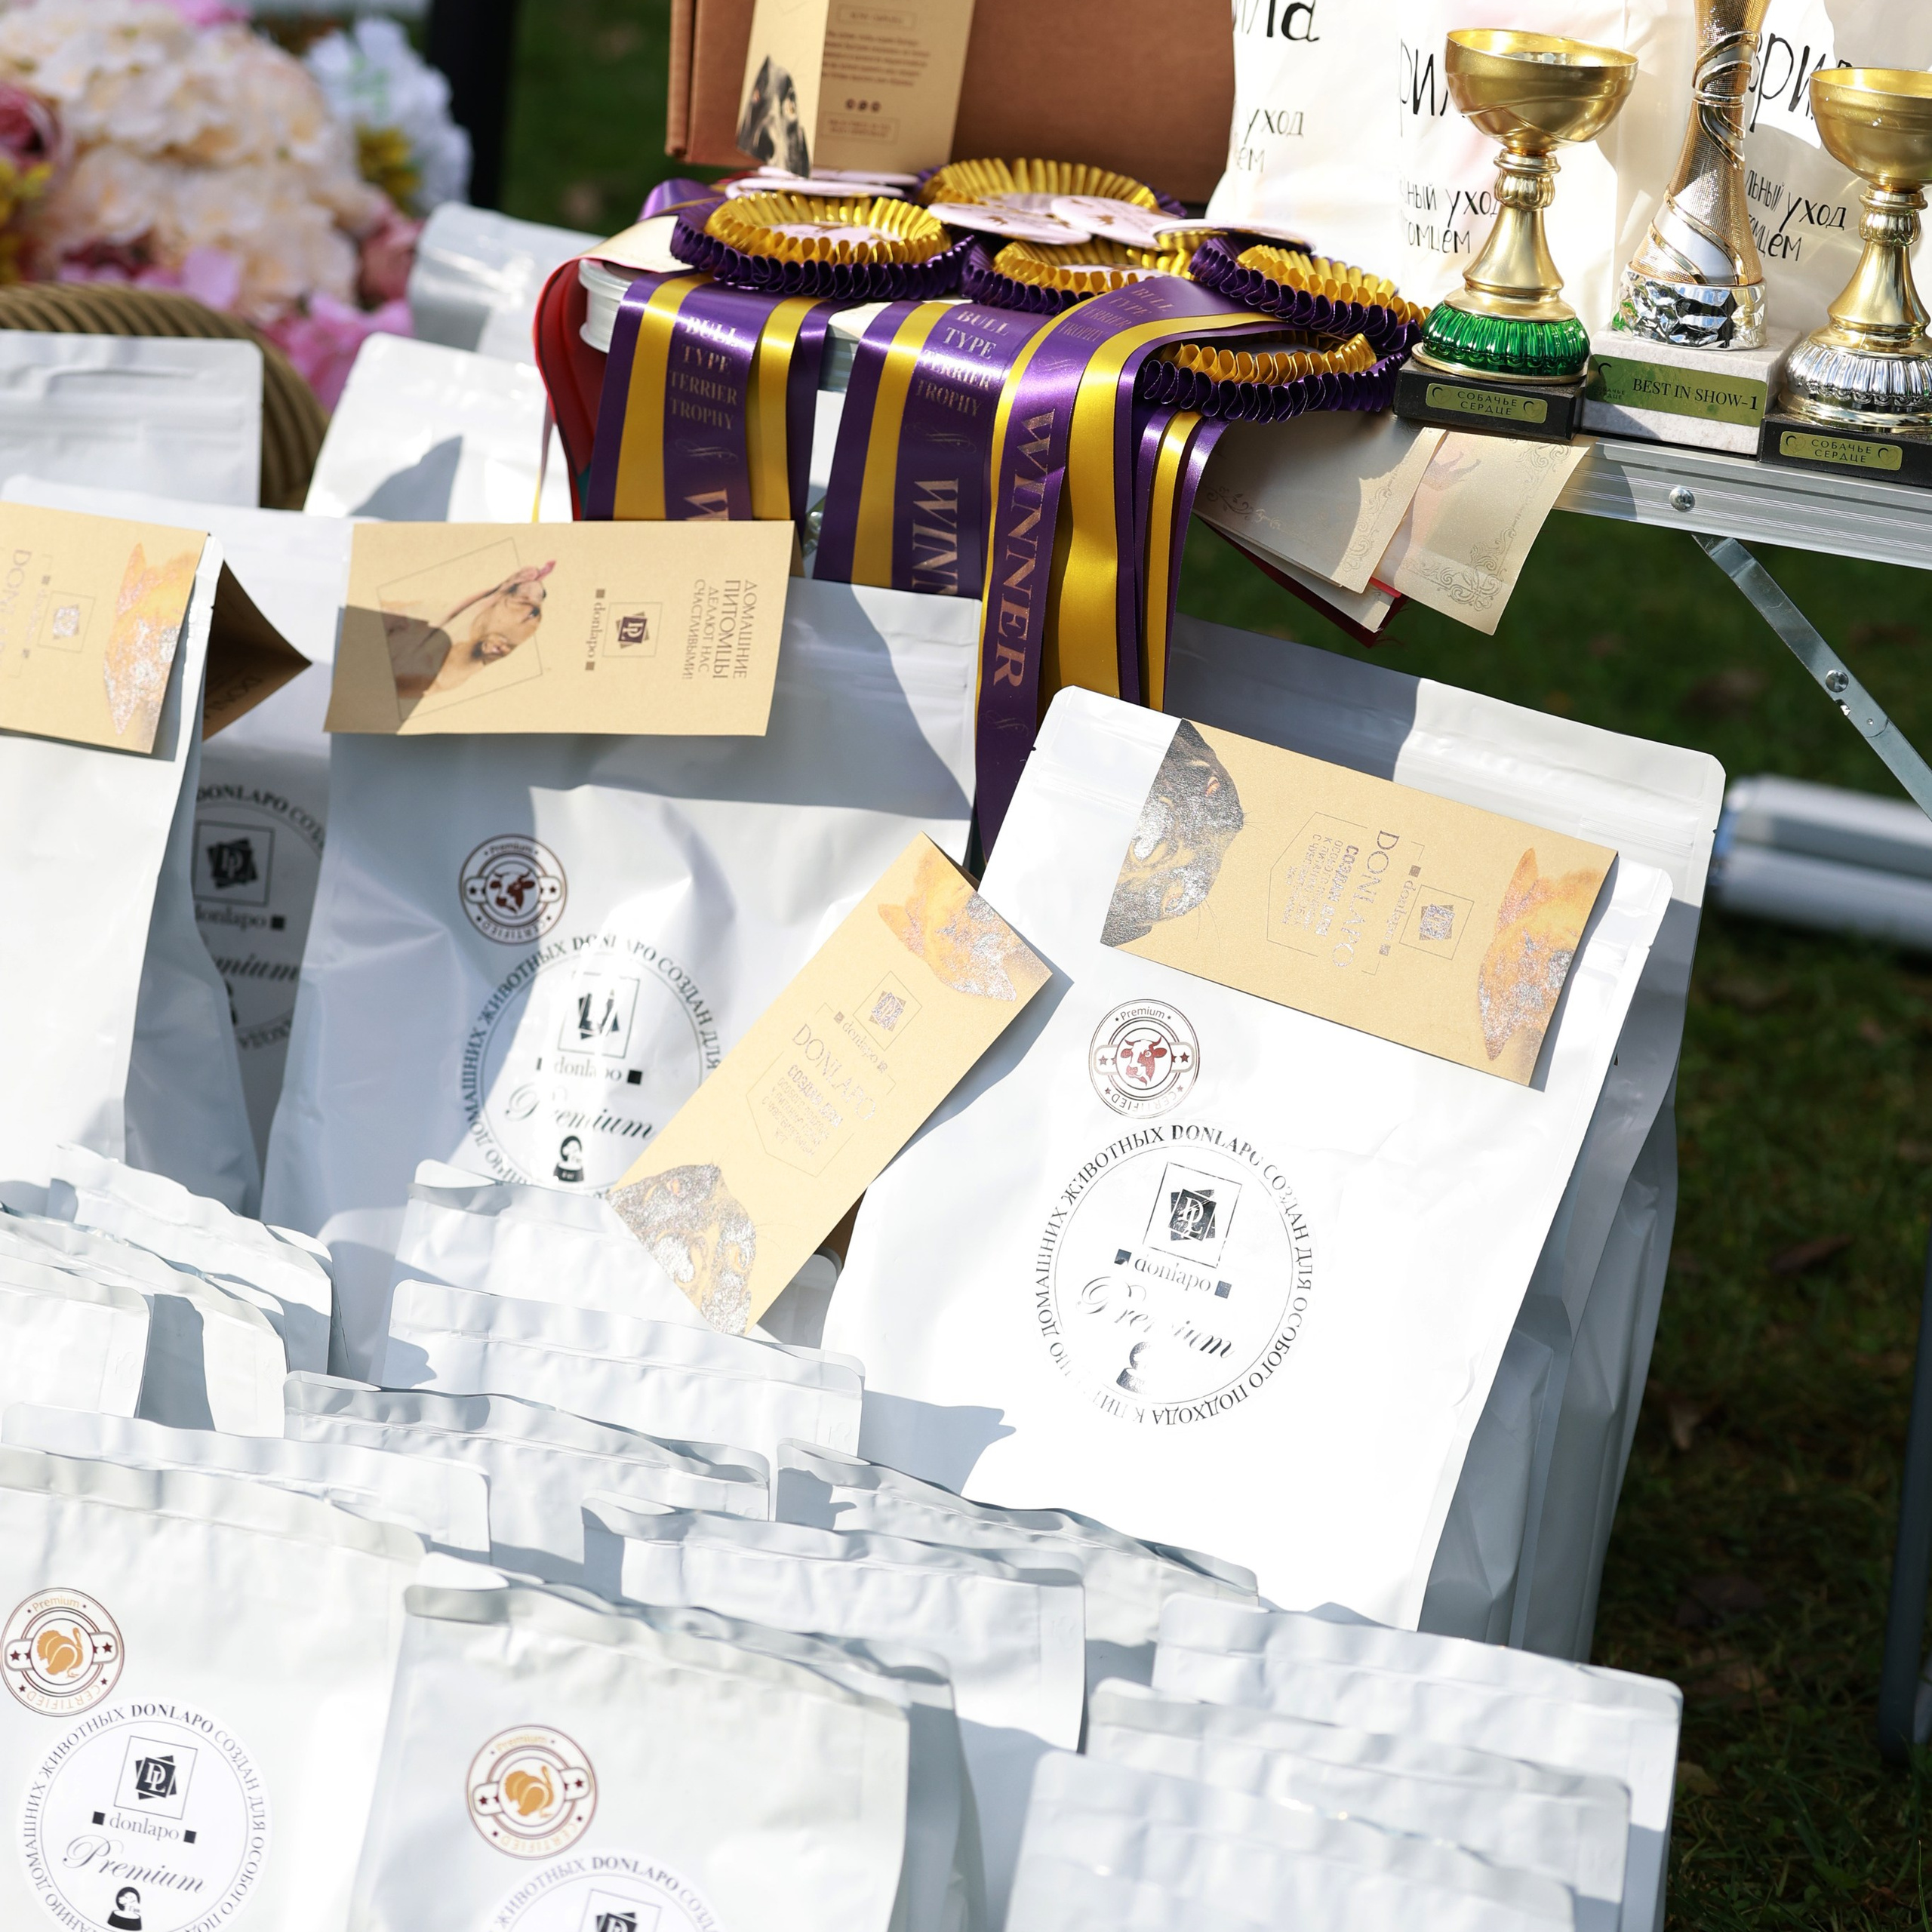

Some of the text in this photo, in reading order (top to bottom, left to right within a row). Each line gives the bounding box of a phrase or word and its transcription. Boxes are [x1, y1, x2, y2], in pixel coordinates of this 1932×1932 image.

[1779, 192, 1847, 232] уход
[956, 311, 1009, 336] BULL
[1078, 305, 1132, 328] TERRIER
[1109, 297, 1152, 317] TYPE
[685, 315, 739, 347] BULL
[943, 327, 997, 360] TYPE
[1058, 321, 1109, 342] TROPHY
[682, 343, 732, 376] TYPE
[669, 370, 738, 407] TERRIER
[916, 379, 981, 417] TROPHY
[1457, 391, 1518, 407] СОБАЧЬЕ
[1632, 378, 1758, 411] BEST IN SHOW-1
[669, 396, 735, 430] TROPHY
[1460, 401, 1512, 416] СЕРДЦЕ
[1811, 438, 1872, 454] СОБАЧЬЕ
[1814, 449, 1867, 463] СЕРДЦЕ
[993, 408, 1056, 688] WINNER
[586, 602, 606, 658] donlapo
[698, 586, 719, 673] ДЕЛАЮТ НАС
[712, 579, 741, 679] ПИТОМЦЫ
[733, 580, 758, 679] ДОМАШНИЕ
[1332, 830, 1400, 968] DONLAPO
[478, 940, 567, 1023] ЖИВОТНЫХ
[657, 956, 713, 1026] СОЗДАН
[702, 1029, 721, 1070] ДЛЯ
[1120, 1006, 1165, 1021] Premium
[792, 1023, 876, 1121] DONLAPO
[1060, 1126, 1165, 1206] ЖИВОТНЫХ
[1263, 1164, 1310, 1241] СОЗДАН
[1035, 1207, 1068, 1338] ДОМАШНИХ
[1134, 1254, 1211, 1291] donlapo
[1294, 1247, 1313, 1291] ДЛЯ
[1248, 1297, 1308, 1389] ОСОБОГО
[1152, 1383, 1250, 1426] ПОДХОДА
[32, 1595, 81, 1612] Premium
[26, 1684, 101, 1710] CERTIFIED
[131, 1703, 214, 1734] DONLAPO
[39, 1706, 126, 1779] ЖИВОТНЫХ
[214, 1729, 260, 1792] СОЗДАН
[109, 1813, 180, 1841] donlapo
[248, 1795, 266, 1832] ДЛЯ
[23, 1783, 46, 1891] ДОМАШНИХ
[63, 1834, 206, 1894] Premium
[220, 1835, 265, 1916] ОСОБОГО
[494, 1858, 586, 1926] ЖИВОТНЫХ
[592, 1857, 679, 1891] DONLAPO
